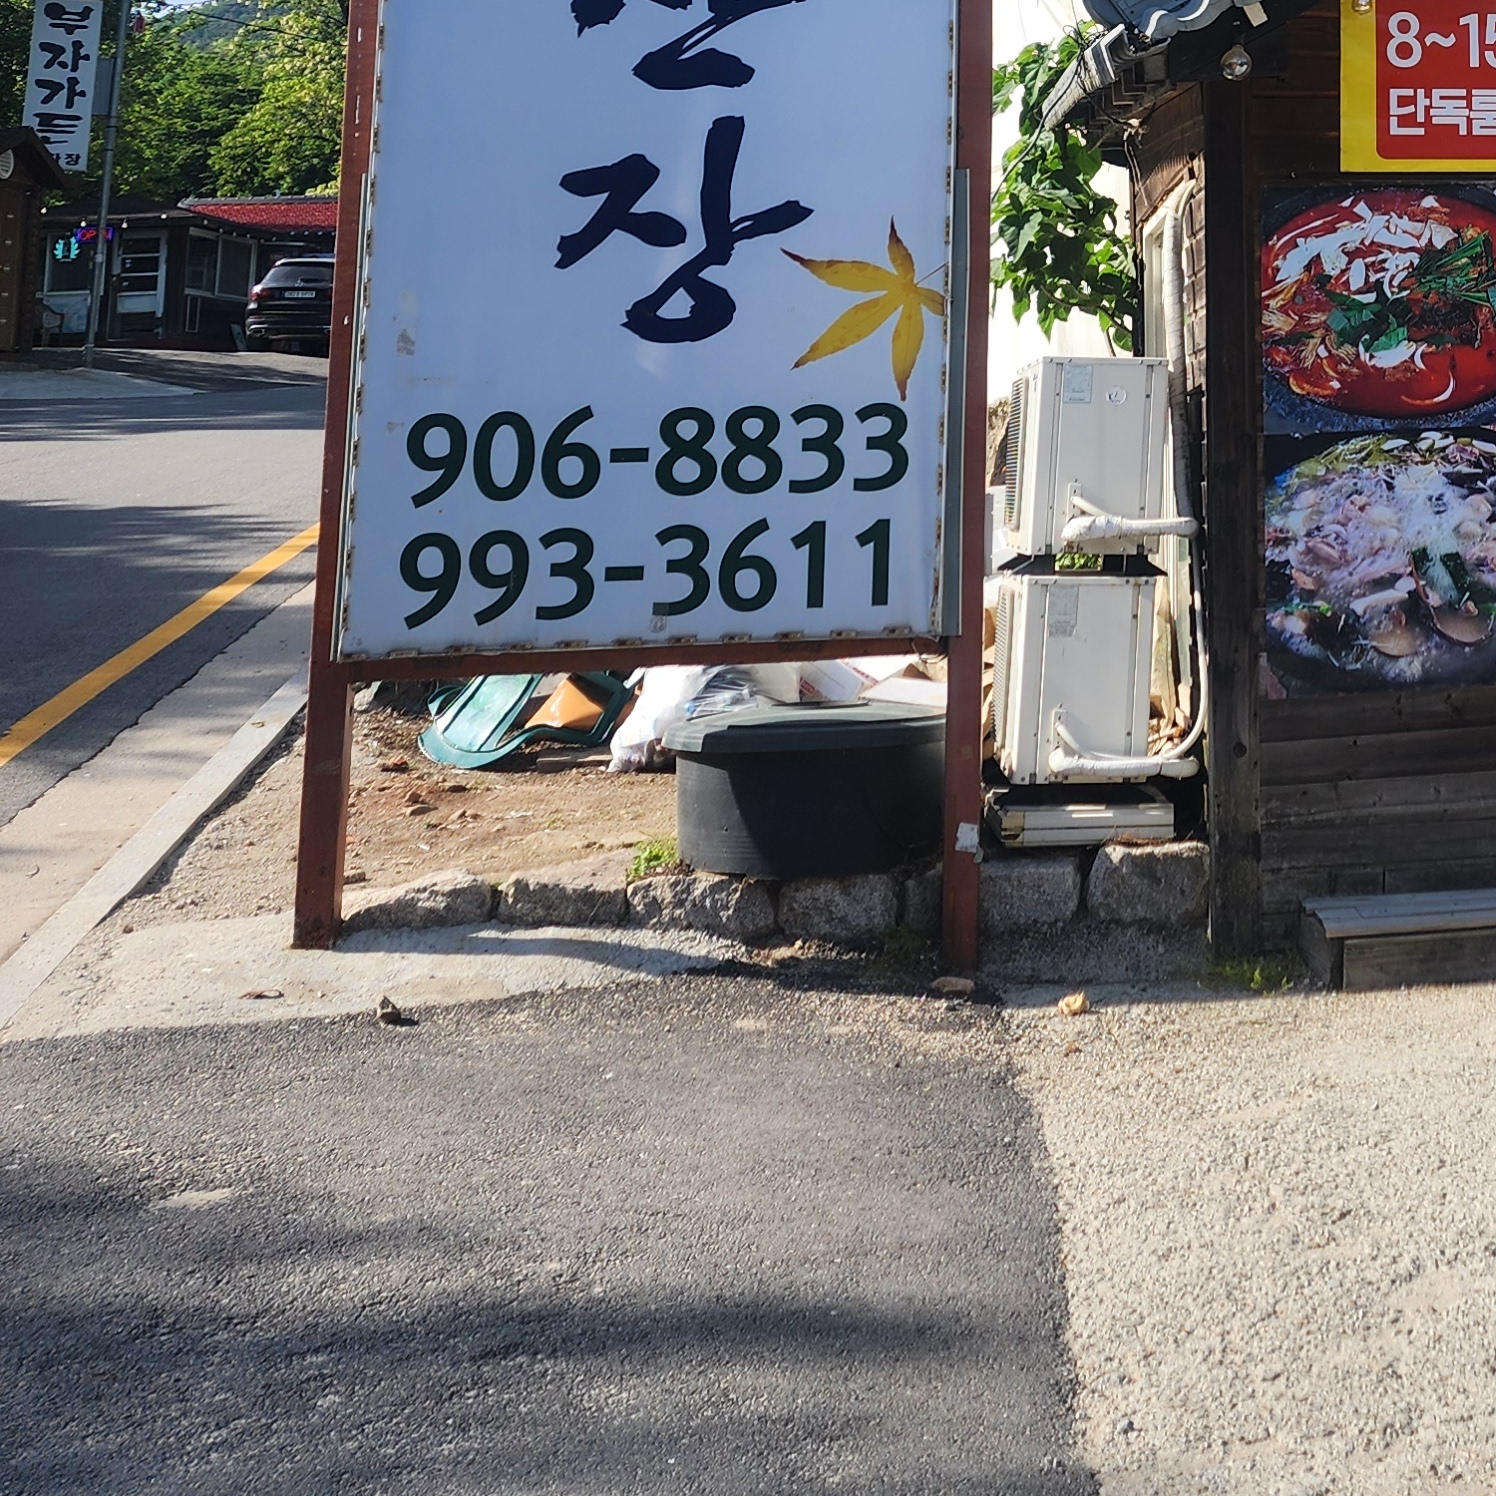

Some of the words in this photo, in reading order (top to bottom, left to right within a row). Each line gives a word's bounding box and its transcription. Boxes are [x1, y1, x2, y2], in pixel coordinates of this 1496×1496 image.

[33, 2, 94, 145] 부자가든
[406, 402, 909, 509] 906-8833
[400, 516, 892, 630] 993-3611
